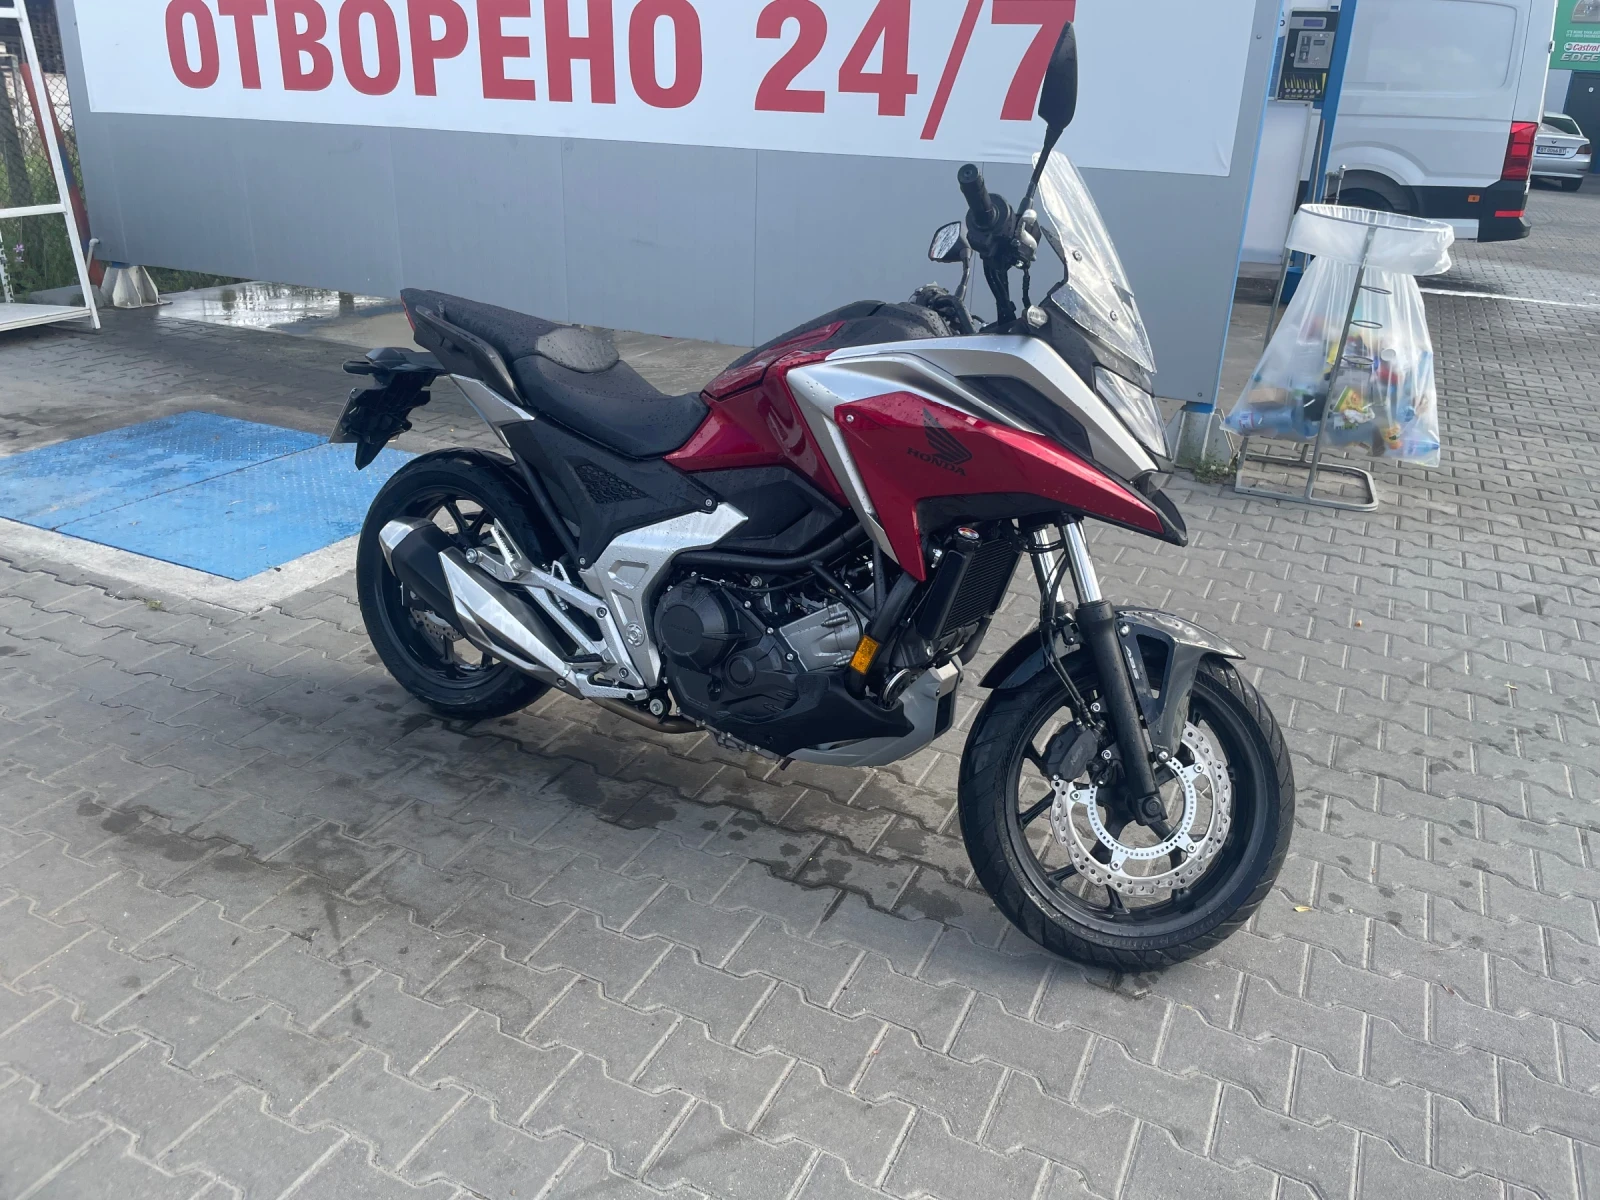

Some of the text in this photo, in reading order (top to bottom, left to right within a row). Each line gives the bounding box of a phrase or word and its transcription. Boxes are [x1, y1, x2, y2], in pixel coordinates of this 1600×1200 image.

[1560, 52, 1600, 62] EDGE
[1573, 43, 1600, 52] Castrol
[165, 0, 1077, 140] ОТВОРЕНО 24/7
[906, 446, 967, 477] HONDA
